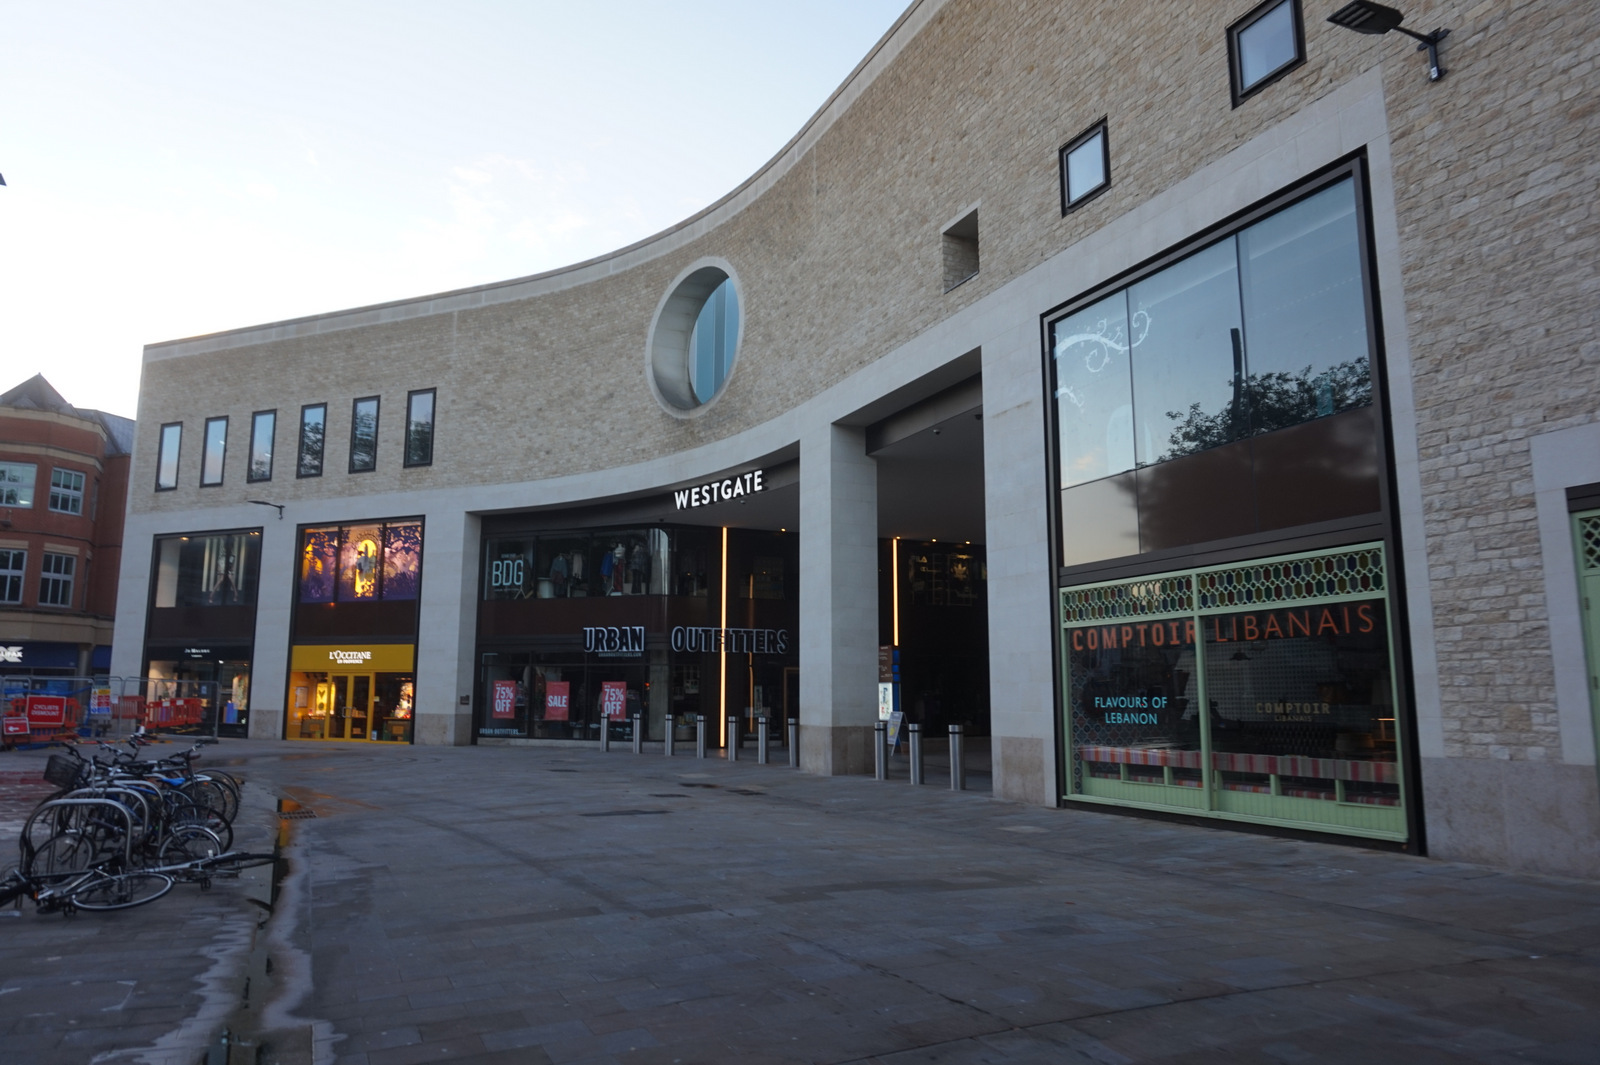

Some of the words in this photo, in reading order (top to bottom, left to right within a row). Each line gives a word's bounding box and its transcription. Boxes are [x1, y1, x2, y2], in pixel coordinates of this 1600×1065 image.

[674, 470, 763, 510] WESTGATE
[492, 560, 524, 586] BDG
[1072, 620, 1196, 651] COMPTOIR
[1214, 604, 1374, 643] LIBANAIS
[583, 626, 645, 653] URBAN
[671, 626, 789, 654] OUTFITTERS
[329, 650, 372, 660] L'OCCITANE
[496, 687, 513, 699] 75%
[604, 688, 624, 701] 75%
[495, 699, 511, 712] OFF
[547, 695, 568, 707] SALE
[1094, 696, 1148, 708] FLAVOURS
[1151, 696, 1168, 708] OF
[604, 701, 622, 715] OFF
[1256, 702, 1330, 714] COMPTOIR
[1105, 712, 1158, 725] LEBANON
